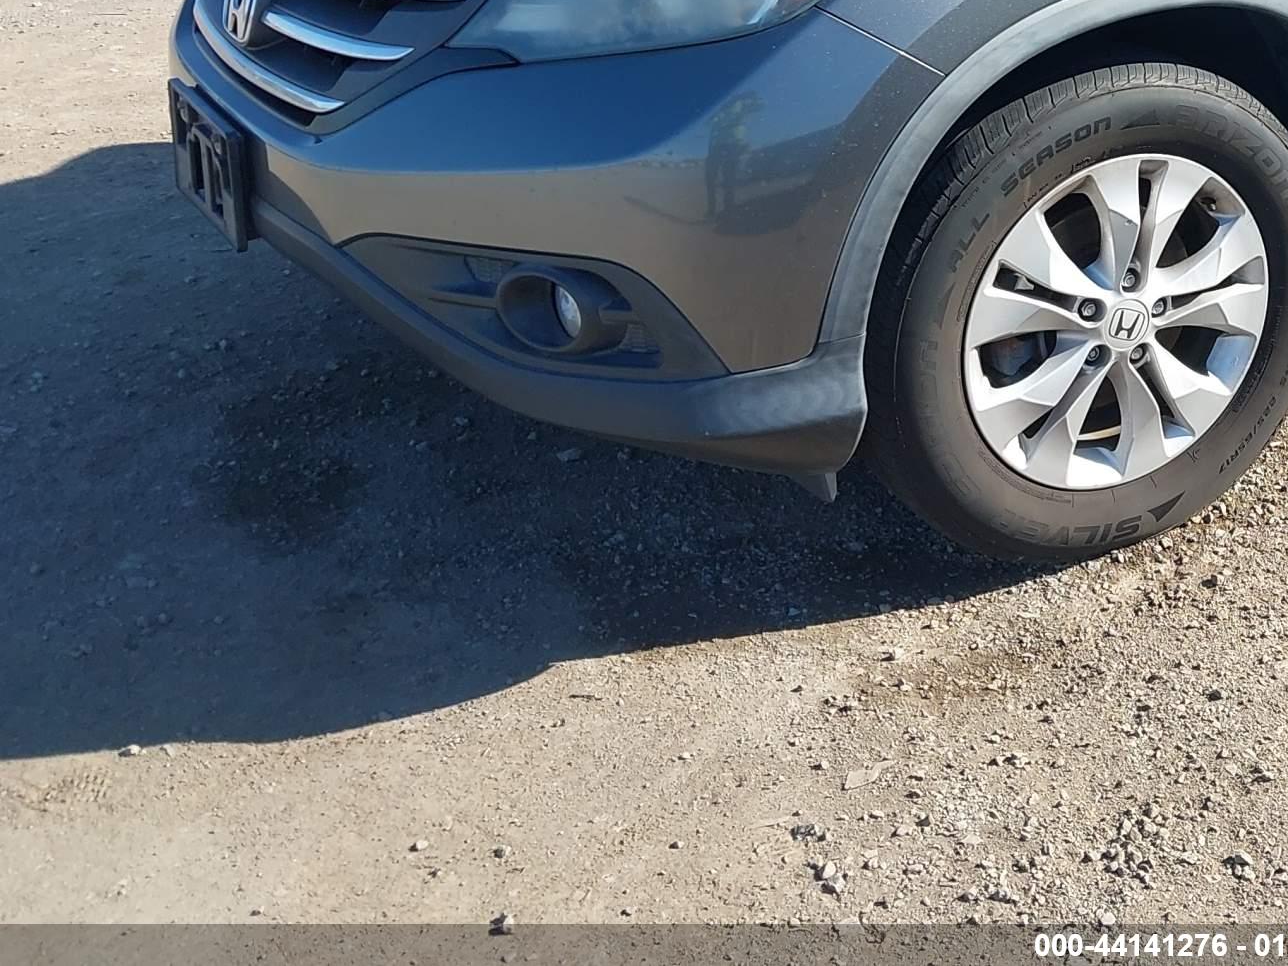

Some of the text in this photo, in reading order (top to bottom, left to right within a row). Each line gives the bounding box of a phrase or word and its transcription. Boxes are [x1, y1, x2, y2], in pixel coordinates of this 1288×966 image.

[949, 212, 990, 273] ALL
[1000, 116, 1112, 198] SEASON
[990, 509, 1142, 547] SILVER
